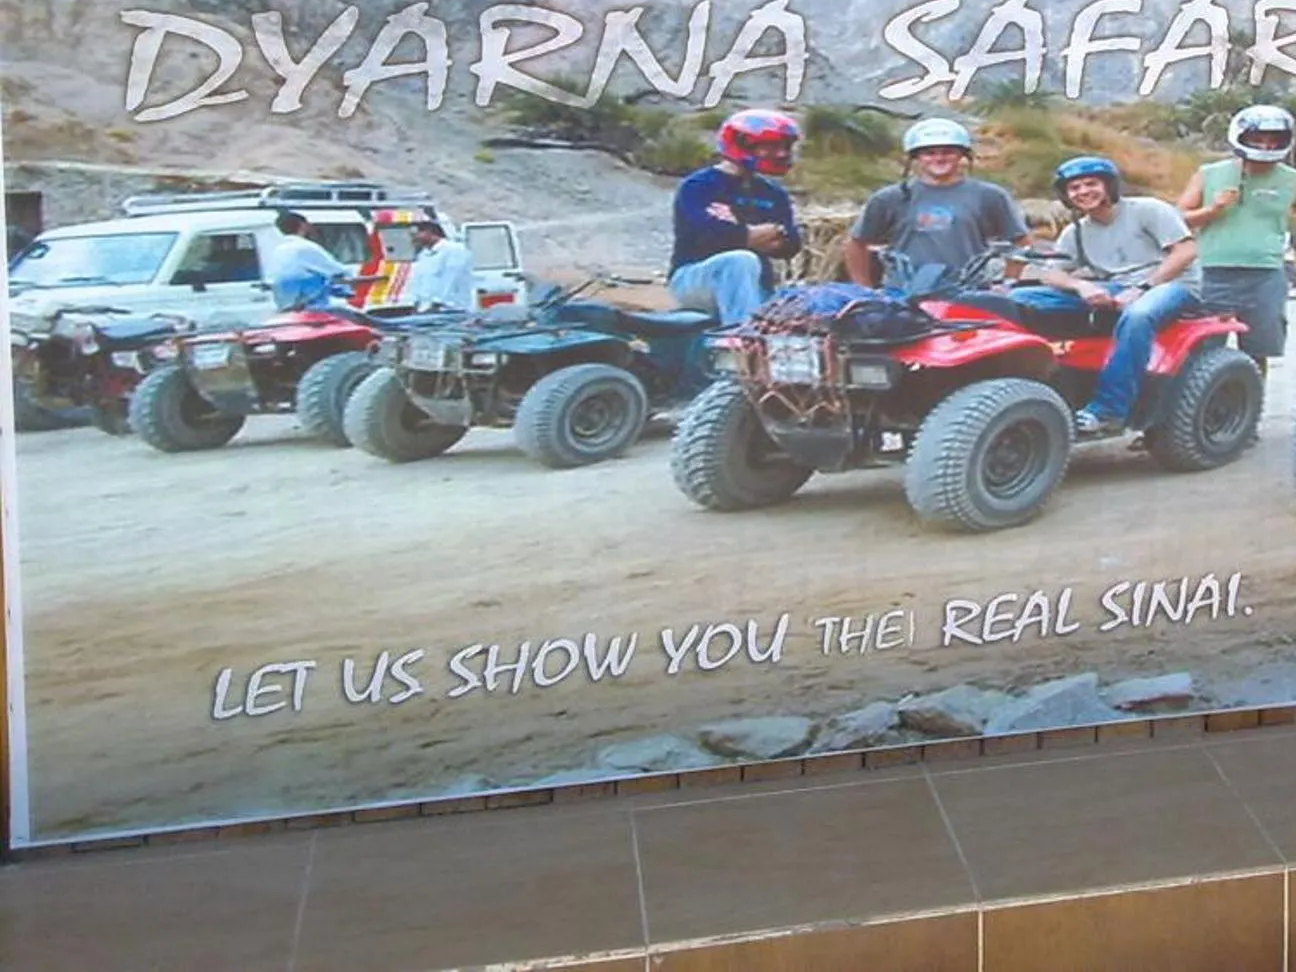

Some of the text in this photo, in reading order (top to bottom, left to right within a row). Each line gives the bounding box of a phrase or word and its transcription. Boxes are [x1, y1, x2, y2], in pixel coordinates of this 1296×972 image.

[210, 660, 317, 720] LET
[342, 647, 424, 704] US
[447, 630, 639, 698] SHOW
[660, 612, 790, 674] YOU
[942, 586, 1081, 647] REAL
[1100, 571, 1254, 632] SINAI.
